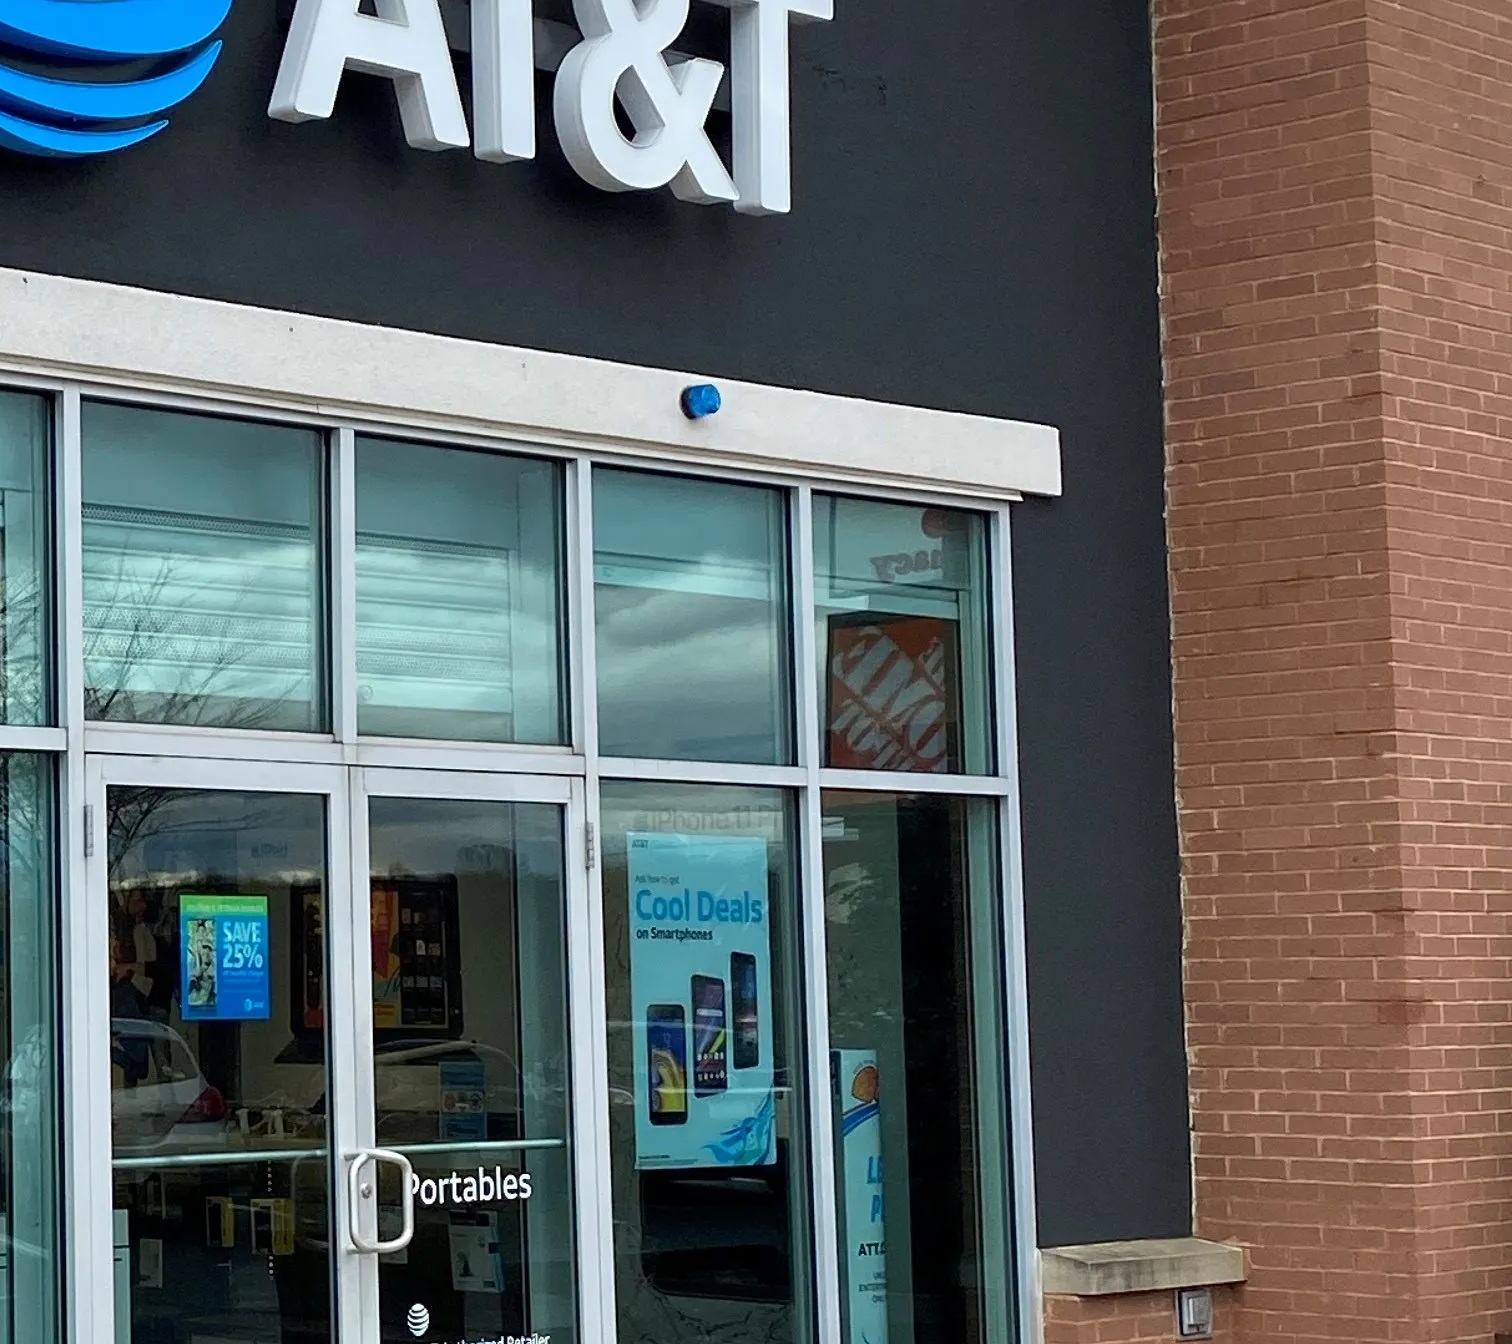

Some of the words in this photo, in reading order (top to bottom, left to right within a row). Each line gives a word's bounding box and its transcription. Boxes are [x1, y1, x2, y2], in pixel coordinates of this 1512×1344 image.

[635, 888, 690, 922] Cool
[697, 890, 763, 923] Deals
[222, 921, 262, 943] SAVE
[636, 928, 649, 940] on
[650, 927, 713, 943] Smartphones
[222, 943, 263, 968] 25%
